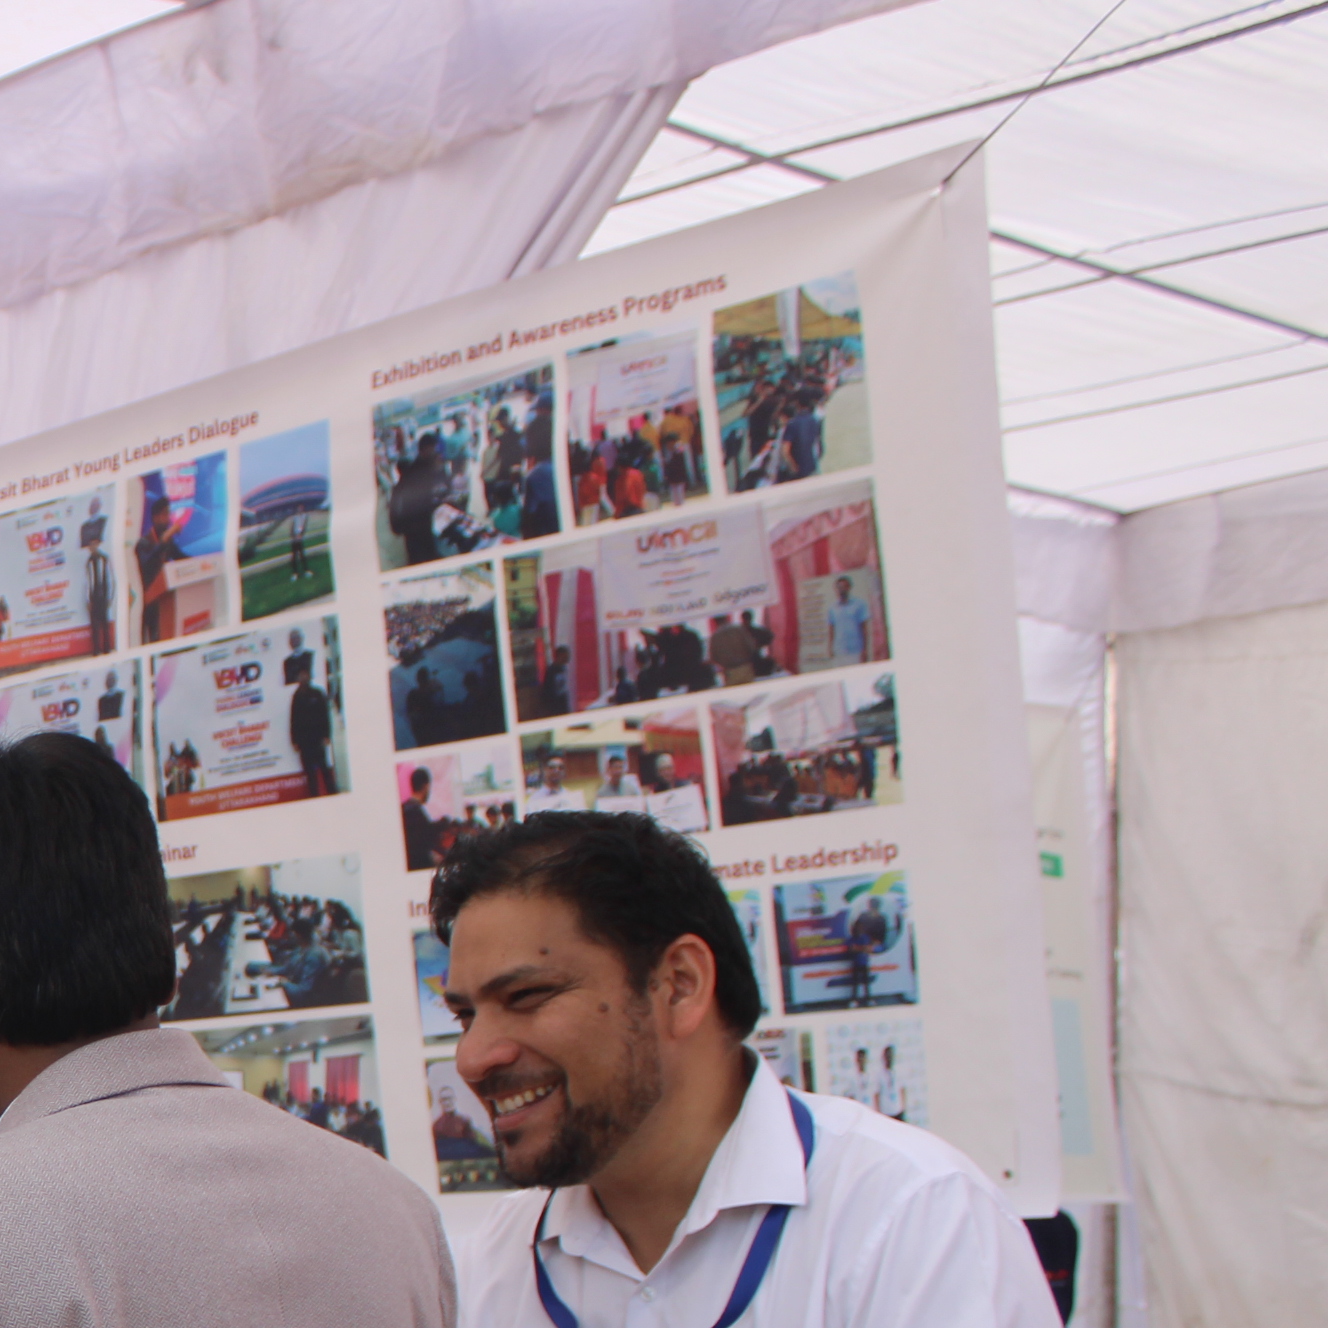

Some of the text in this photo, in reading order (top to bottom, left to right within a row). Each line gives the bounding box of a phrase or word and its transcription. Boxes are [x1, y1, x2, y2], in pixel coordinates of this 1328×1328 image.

[370, 273, 728, 391] Exhibition and Awareness Programs
[20, 467, 70, 496] Bharat
[73, 453, 121, 484] Young
[123, 434, 186, 465] Leaders
[187, 410, 260, 446] Dialogue
[770, 839, 898, 875] Leadership
